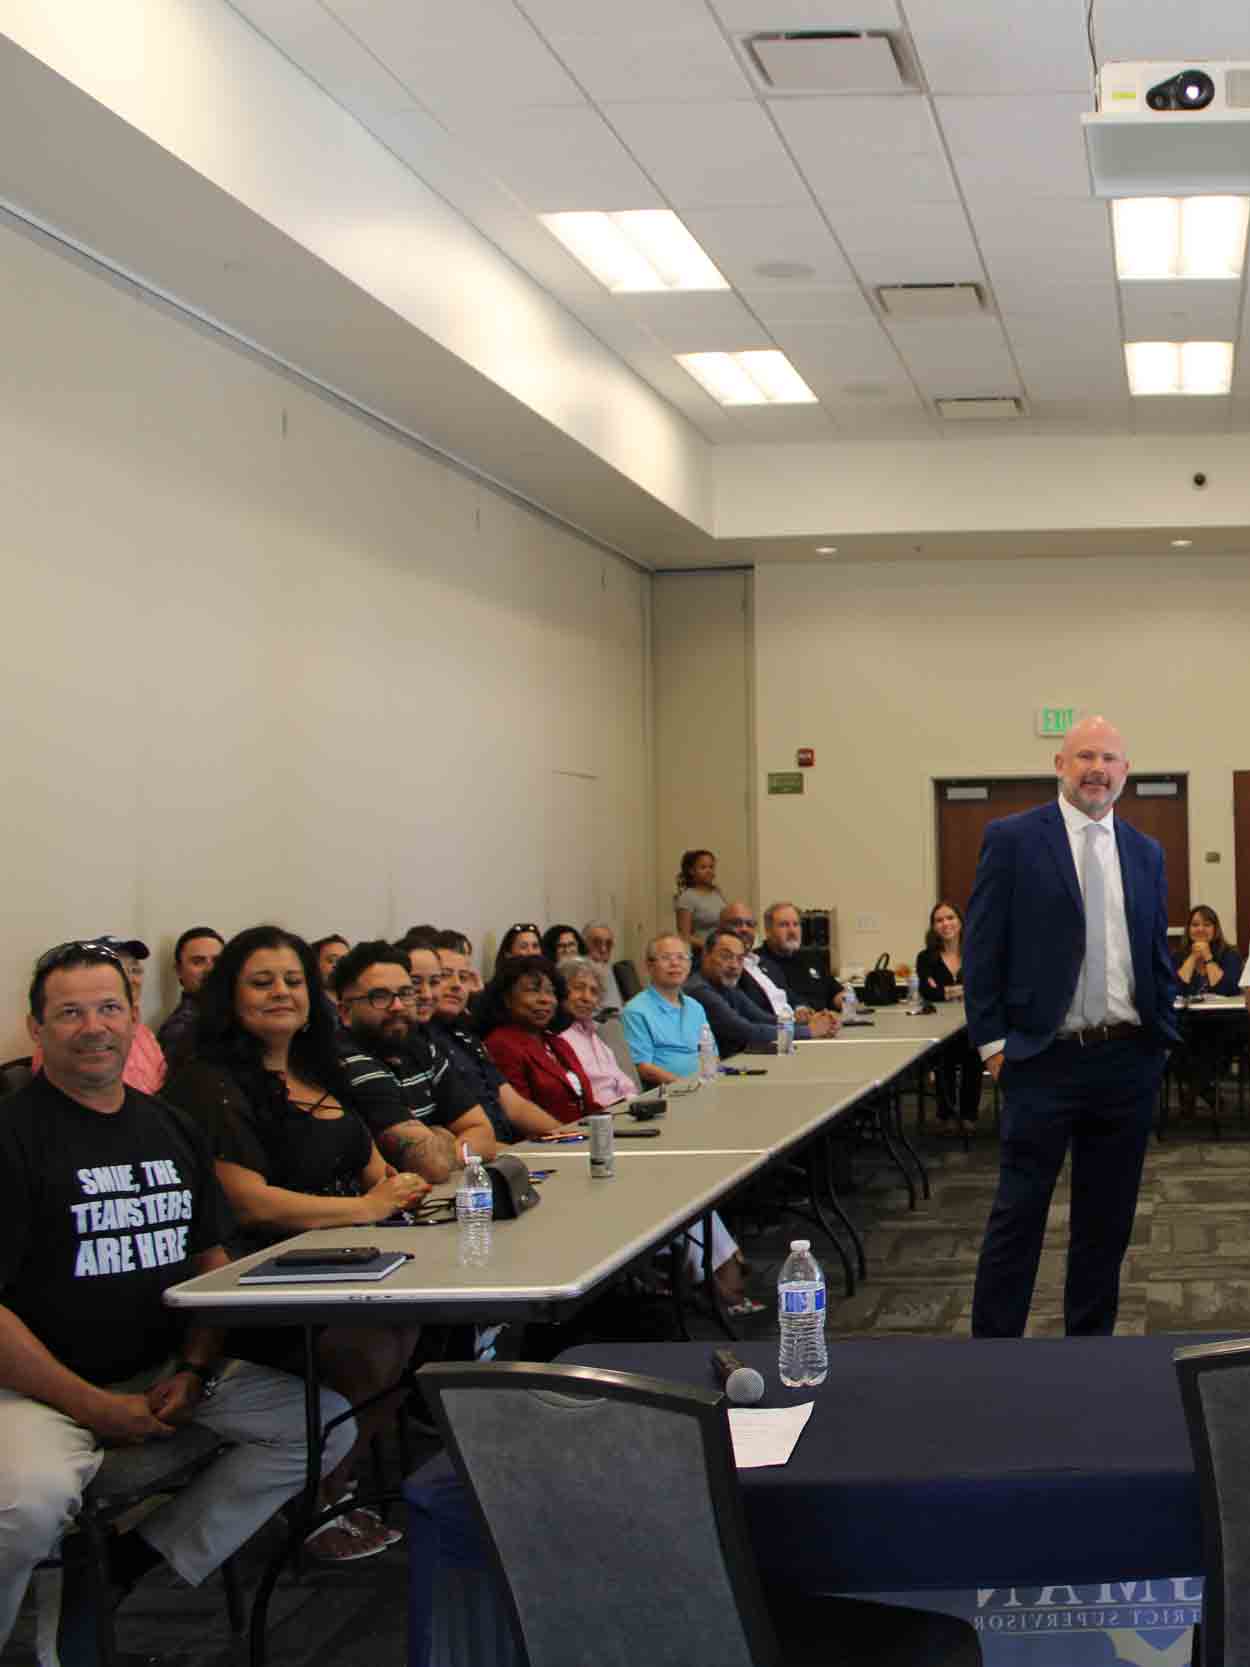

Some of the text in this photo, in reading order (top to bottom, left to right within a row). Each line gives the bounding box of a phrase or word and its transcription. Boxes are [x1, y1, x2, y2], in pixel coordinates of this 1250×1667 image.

[141, 1159, 181, 1187] THE
[70, 1189, 192, 1234] TEAMSTERS
[75, 1225, 189, 1277] ARE HERE
